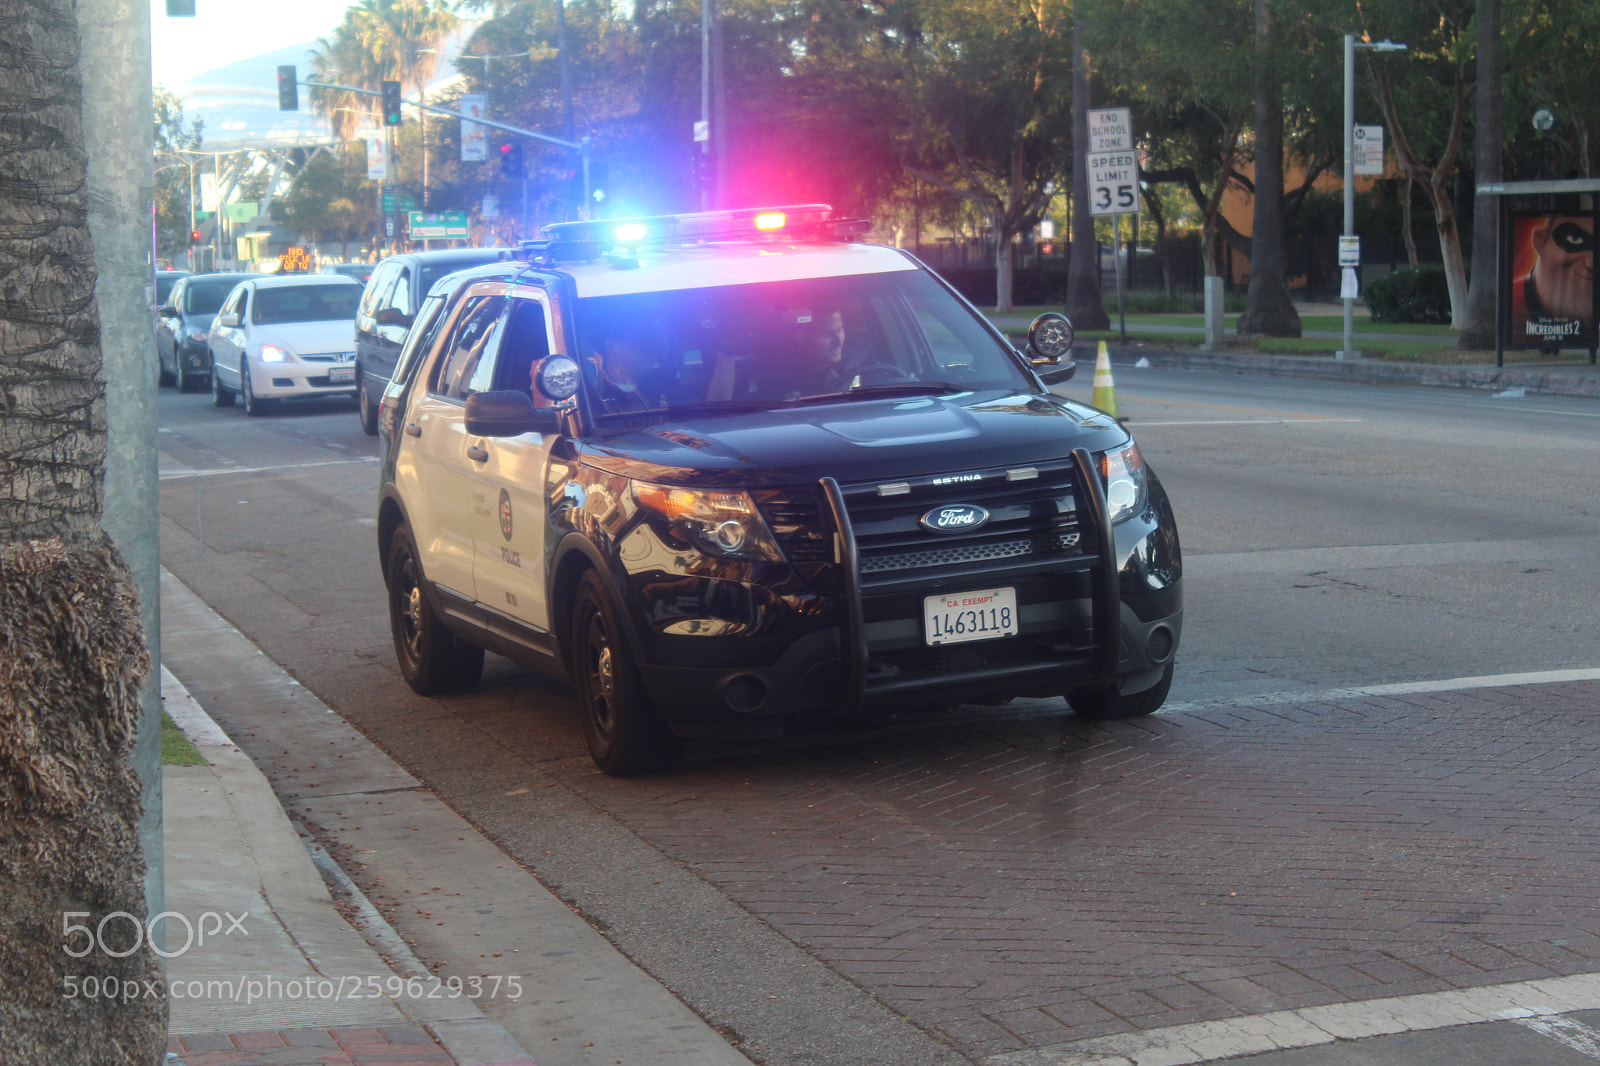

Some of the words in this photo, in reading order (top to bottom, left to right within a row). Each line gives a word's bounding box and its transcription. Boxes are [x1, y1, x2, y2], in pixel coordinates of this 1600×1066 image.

[1100, 113, 1118, 123] END
[1092, 124, 1128, 136] SCHOOL
[1099, 137, 1122, 148] ZONE
[1092, 156, 1132, 168] SPEED
[1096, 171, 1129, 182] LIMIT
[1096, 185, 1135, 209] 35
[1525, 320, 1573, 335] INCREDIBLES
[1573, 320, 1580, 335] 2
[932, 474, 982, 485] SETINA
[937, 508, 975, 526] Ford
[501, 546, 521, 569] POLICE
[947, 600, 959, 608] CA
[962, 595, 994, 606] EXEMPT
[933, 607, 1011, 637] 1463118
